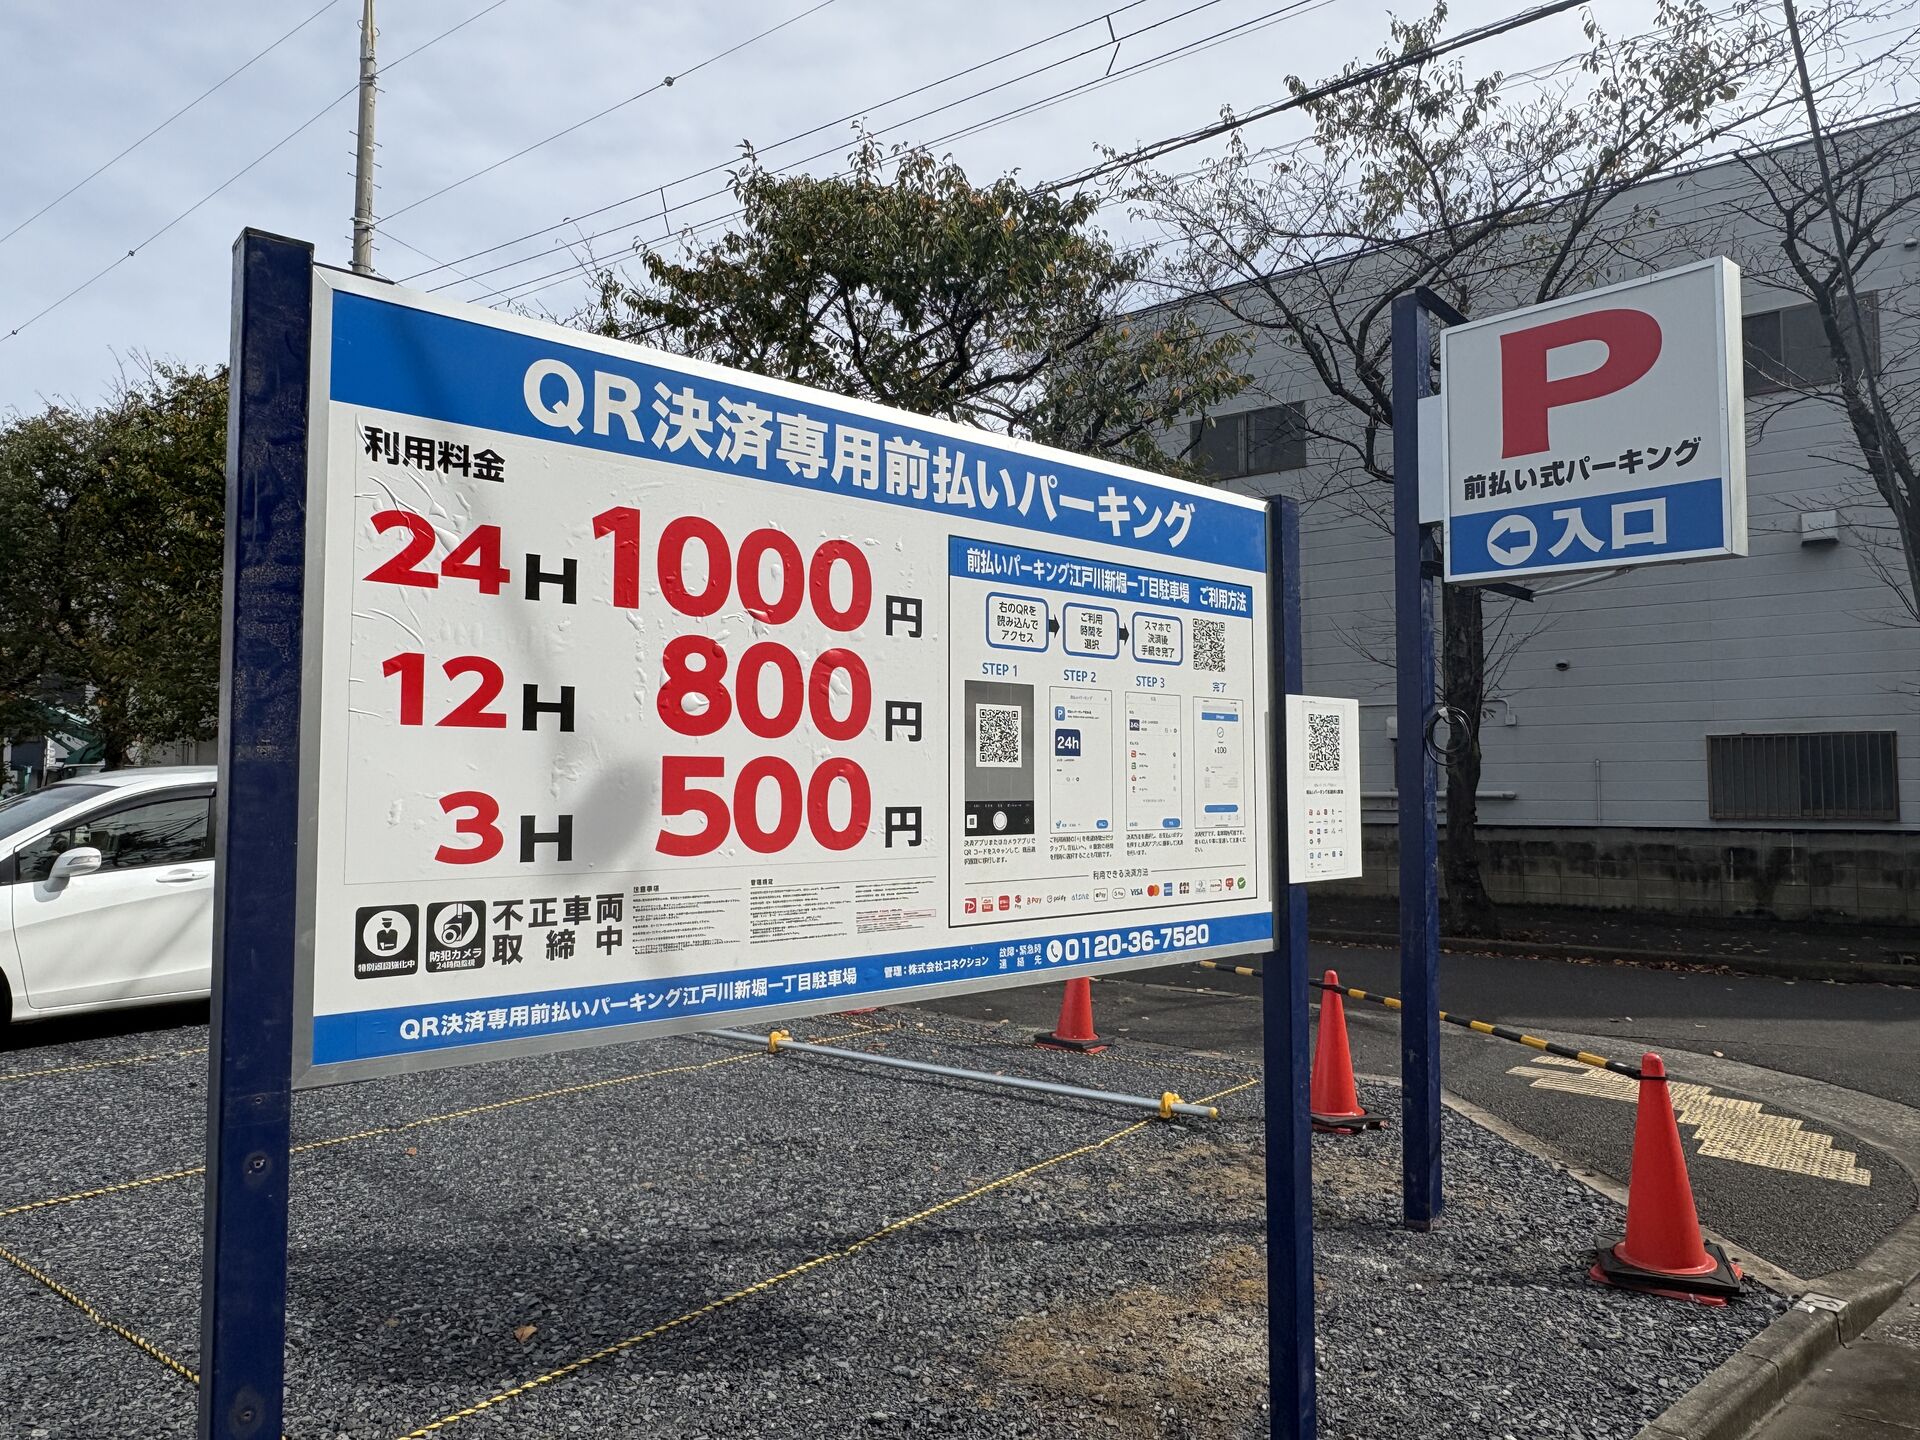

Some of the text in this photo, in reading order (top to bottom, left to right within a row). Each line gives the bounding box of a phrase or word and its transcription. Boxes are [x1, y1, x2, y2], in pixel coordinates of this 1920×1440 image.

[1500, 309, 1662, 460] P
[364, 425, 505, 482] 利用料金
[523, 359, 1195, 548] QR決済専用前払いパーキング
[1464, 436, 1702, 501] 前払い式パーキング
[1548, 497, 1667, 558] 入口
[967, 547, 1247, 612] 前払いパーキング江戸川新堀一丁目駐車場 ご利用方法
[999, 601, 1037, 617] 右のQRを
[997, 614, 1038, 630] 読み込んで
[1081, 612, 1103, 625] ご利用
[1144, 620, 1172, 633] スマホで
[1001, 629, 1034, 643] アクセス
[1080, 625, 1103, 637] 時間を
[982, 662, 1018, 677] STEP 1
[1063, 669, 1097, 683] STEP 2
[1136, 675, 1165, 688] STEP 3
[1212, 682, 1227, 692] 完了
[1057, 736, 1079, 750] 24h
[1093, 868, 1148, 880] 利用できる決済方法
[1130, 888, 1143, 896] VISA
[492, 892, 625, 931] 不正車両
[1064, 923, 1210, 962] 0120-36-7520
[429, 947, 482, 963] 防犯カメラ
[399, 966, 858, 1041] QR決済専用前払いパーキング江戸川新堀一丁目駐車場
